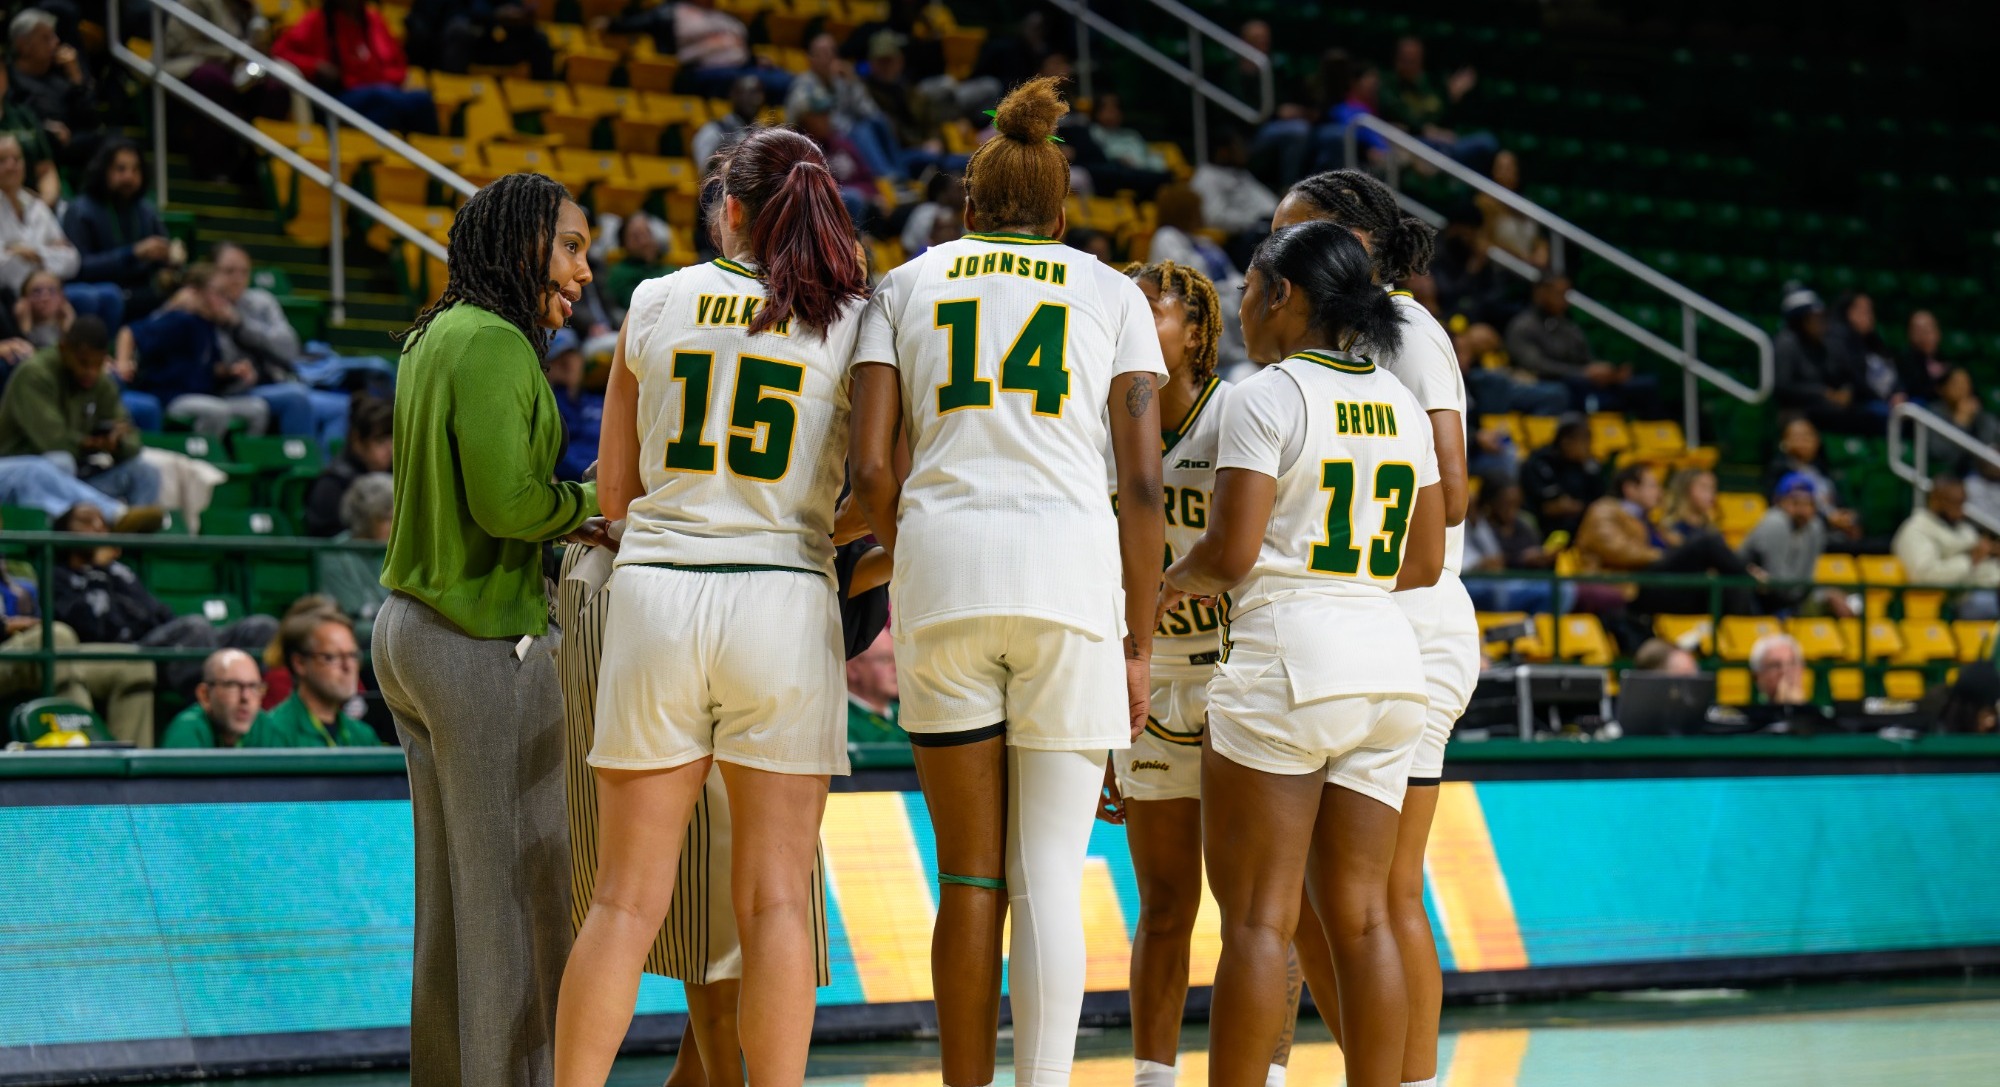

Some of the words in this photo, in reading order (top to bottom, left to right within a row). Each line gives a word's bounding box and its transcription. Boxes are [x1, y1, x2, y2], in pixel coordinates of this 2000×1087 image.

[946, 252, 1068, 287] JOHNSON
[696, 293, 791, 337] VOLKR
[934, 297, 1071, 419] 14
[664, 349, 807, 484] 15
[1334, 400, 1398, 437] BROWN
[1306, 458, 1417, 580] 13
[1131, 759, 1170, 773] Patriots
